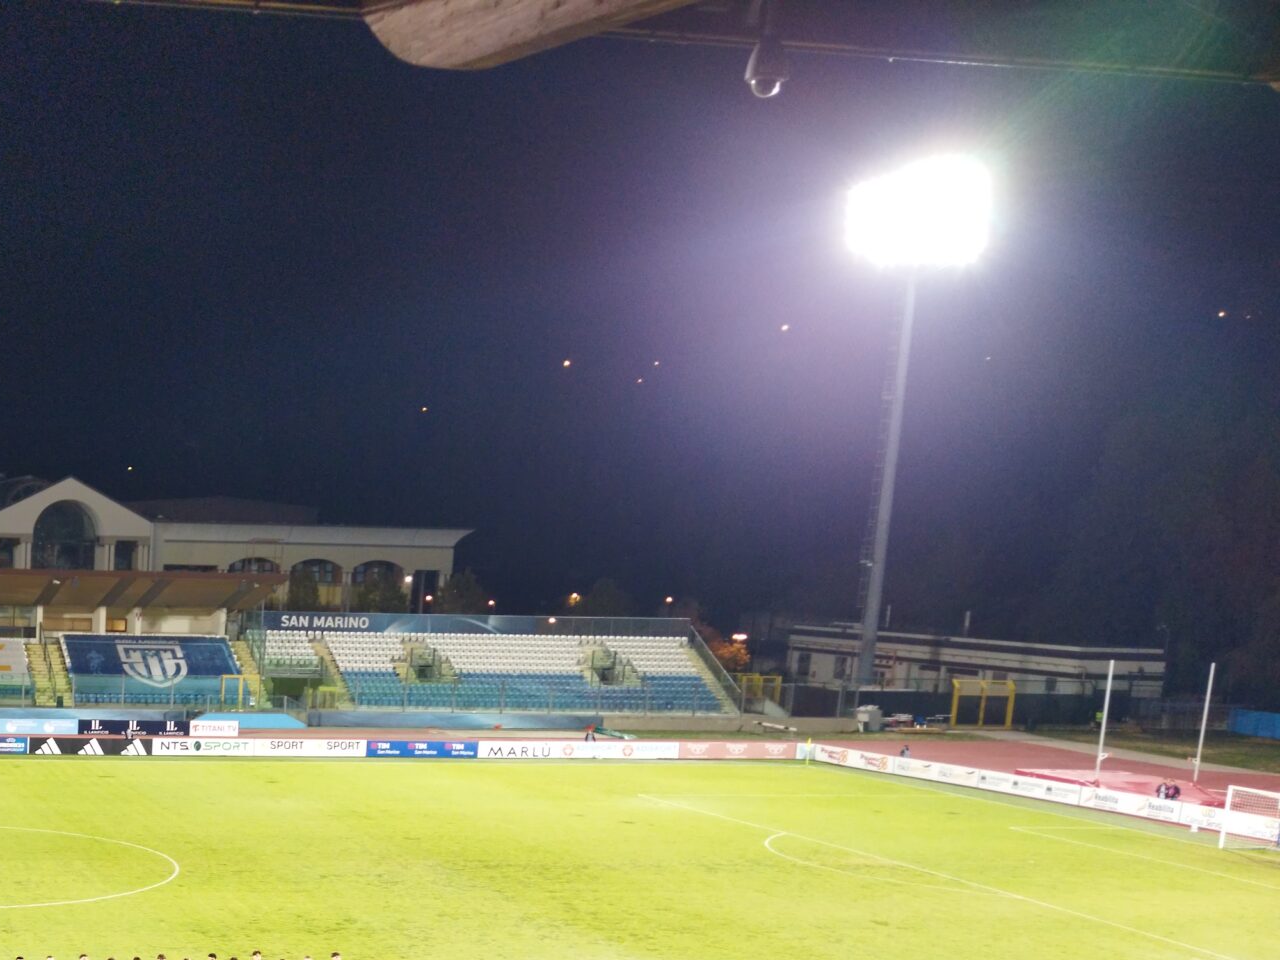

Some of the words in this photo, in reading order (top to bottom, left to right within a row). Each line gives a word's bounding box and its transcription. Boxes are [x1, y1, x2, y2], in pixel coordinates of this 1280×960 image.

[281, 615, 309, 628] SAN
[313, 616, 369, 628] MARINO
[160, 741, 189, 750] NTS
[203, 742, 249, 751] SPORT
[270, 741, 304, 750] SPORT
[327, 741, 360, 750] SPORT
